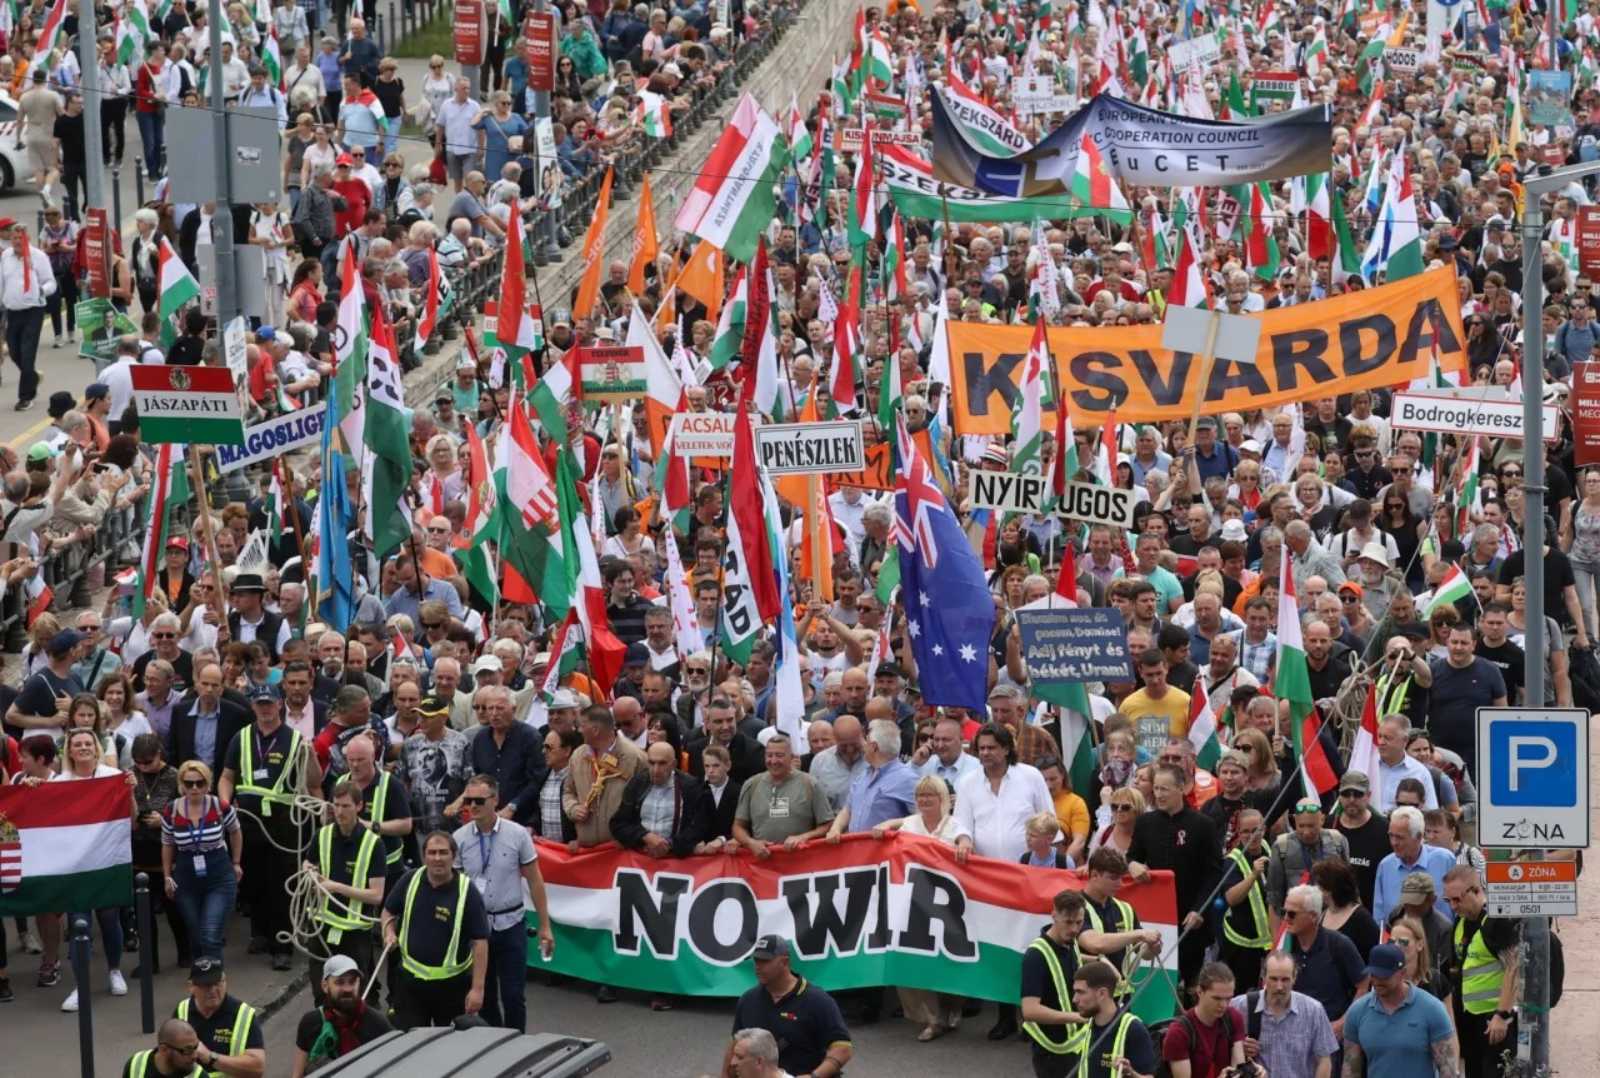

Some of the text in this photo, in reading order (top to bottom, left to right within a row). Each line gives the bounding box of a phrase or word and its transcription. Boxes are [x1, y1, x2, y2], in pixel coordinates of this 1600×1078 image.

[1197, 130, 1260, 144] COUNCIL
[143, 395, 228, 412] JÁSZAPÁTI
[1403, 403, 1546, 428] Bodrogkeresz
[682, 418, 738, 433] ACSAL
[762, 432, 856, 467] PENÉSZLEK
[974, 473, 1128, 522] NYÍRUGOS
[1106, 641, 1124, 656] és
[1509, 736, 1558, 791] P
[1528, 865, 1557, 878] ZÓNA
[612, 867, 759, 967] NO
[1520, 905, 1541, 914] 0501
